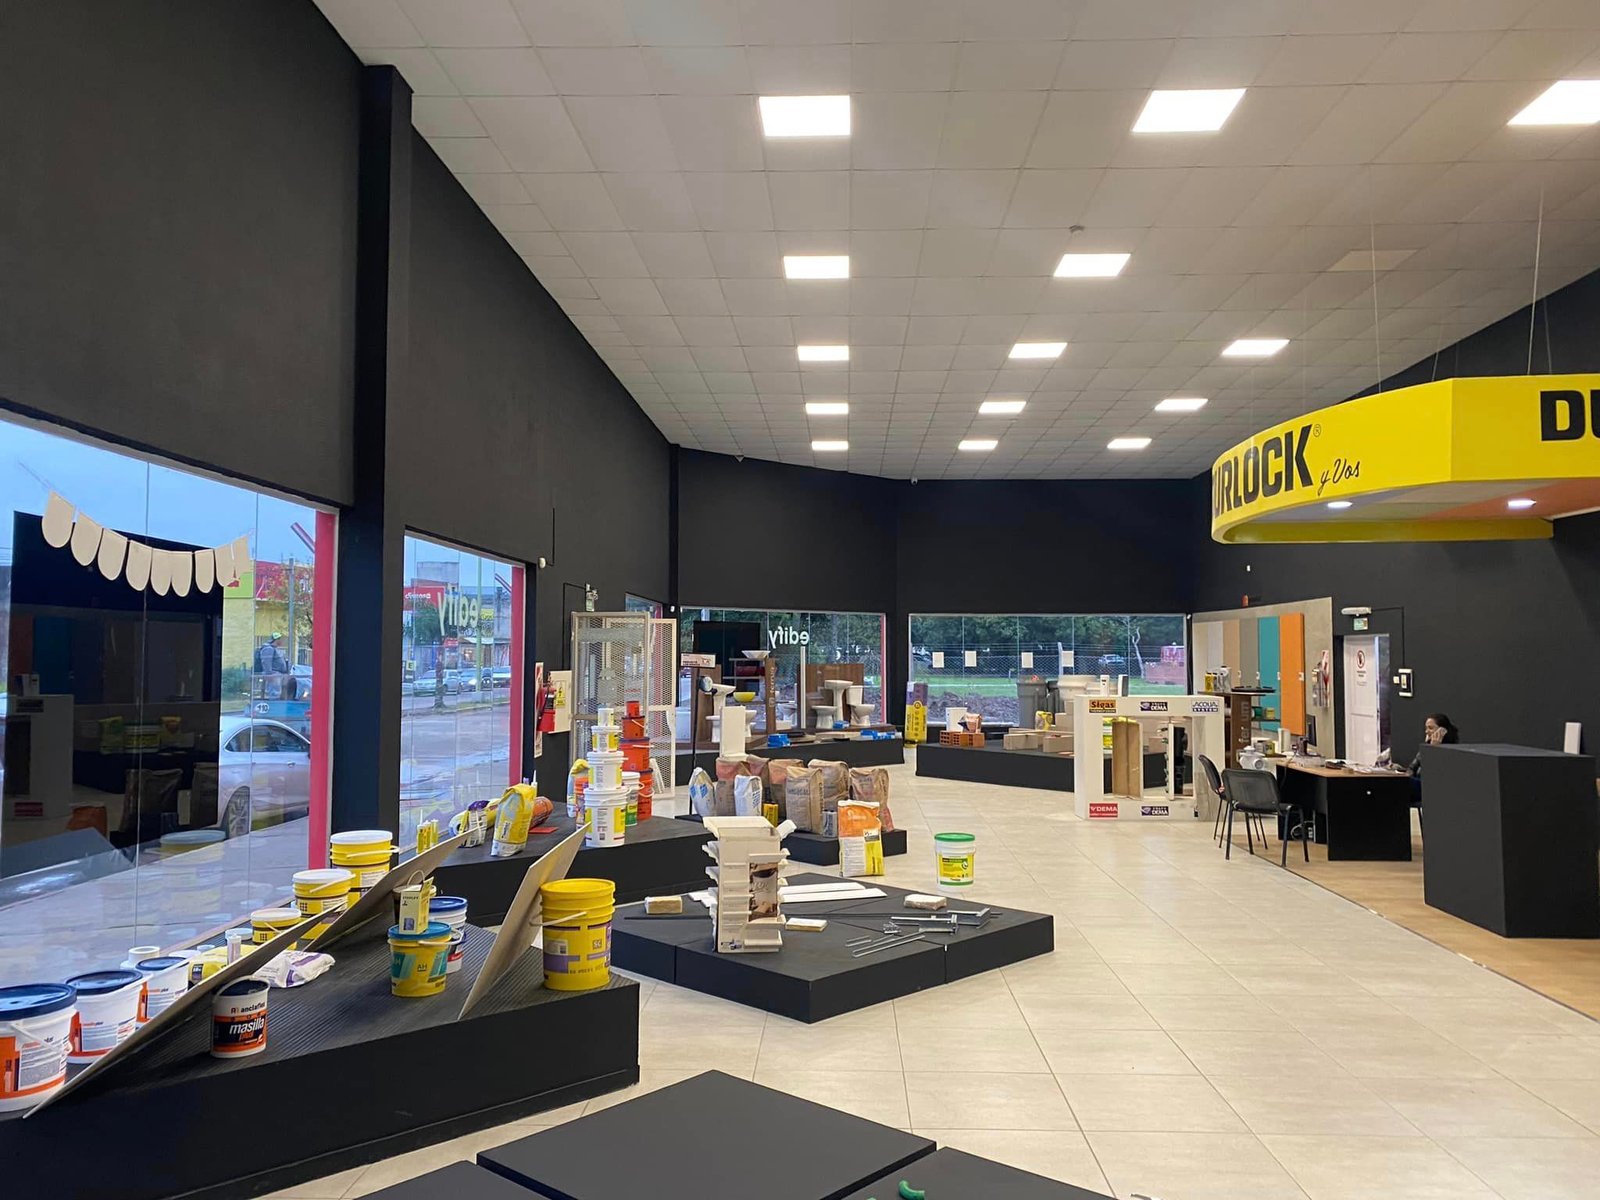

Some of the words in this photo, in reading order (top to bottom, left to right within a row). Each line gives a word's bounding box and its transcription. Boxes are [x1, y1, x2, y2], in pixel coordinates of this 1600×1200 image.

[1540, 389, 1600, 441] D
[1318, 470, 1331, 497] y
[1333, 458, 1361, 484] Vos
[1091, 701, 1115, 710] Sigas
[229, 1017, 265, 1035] masilla
